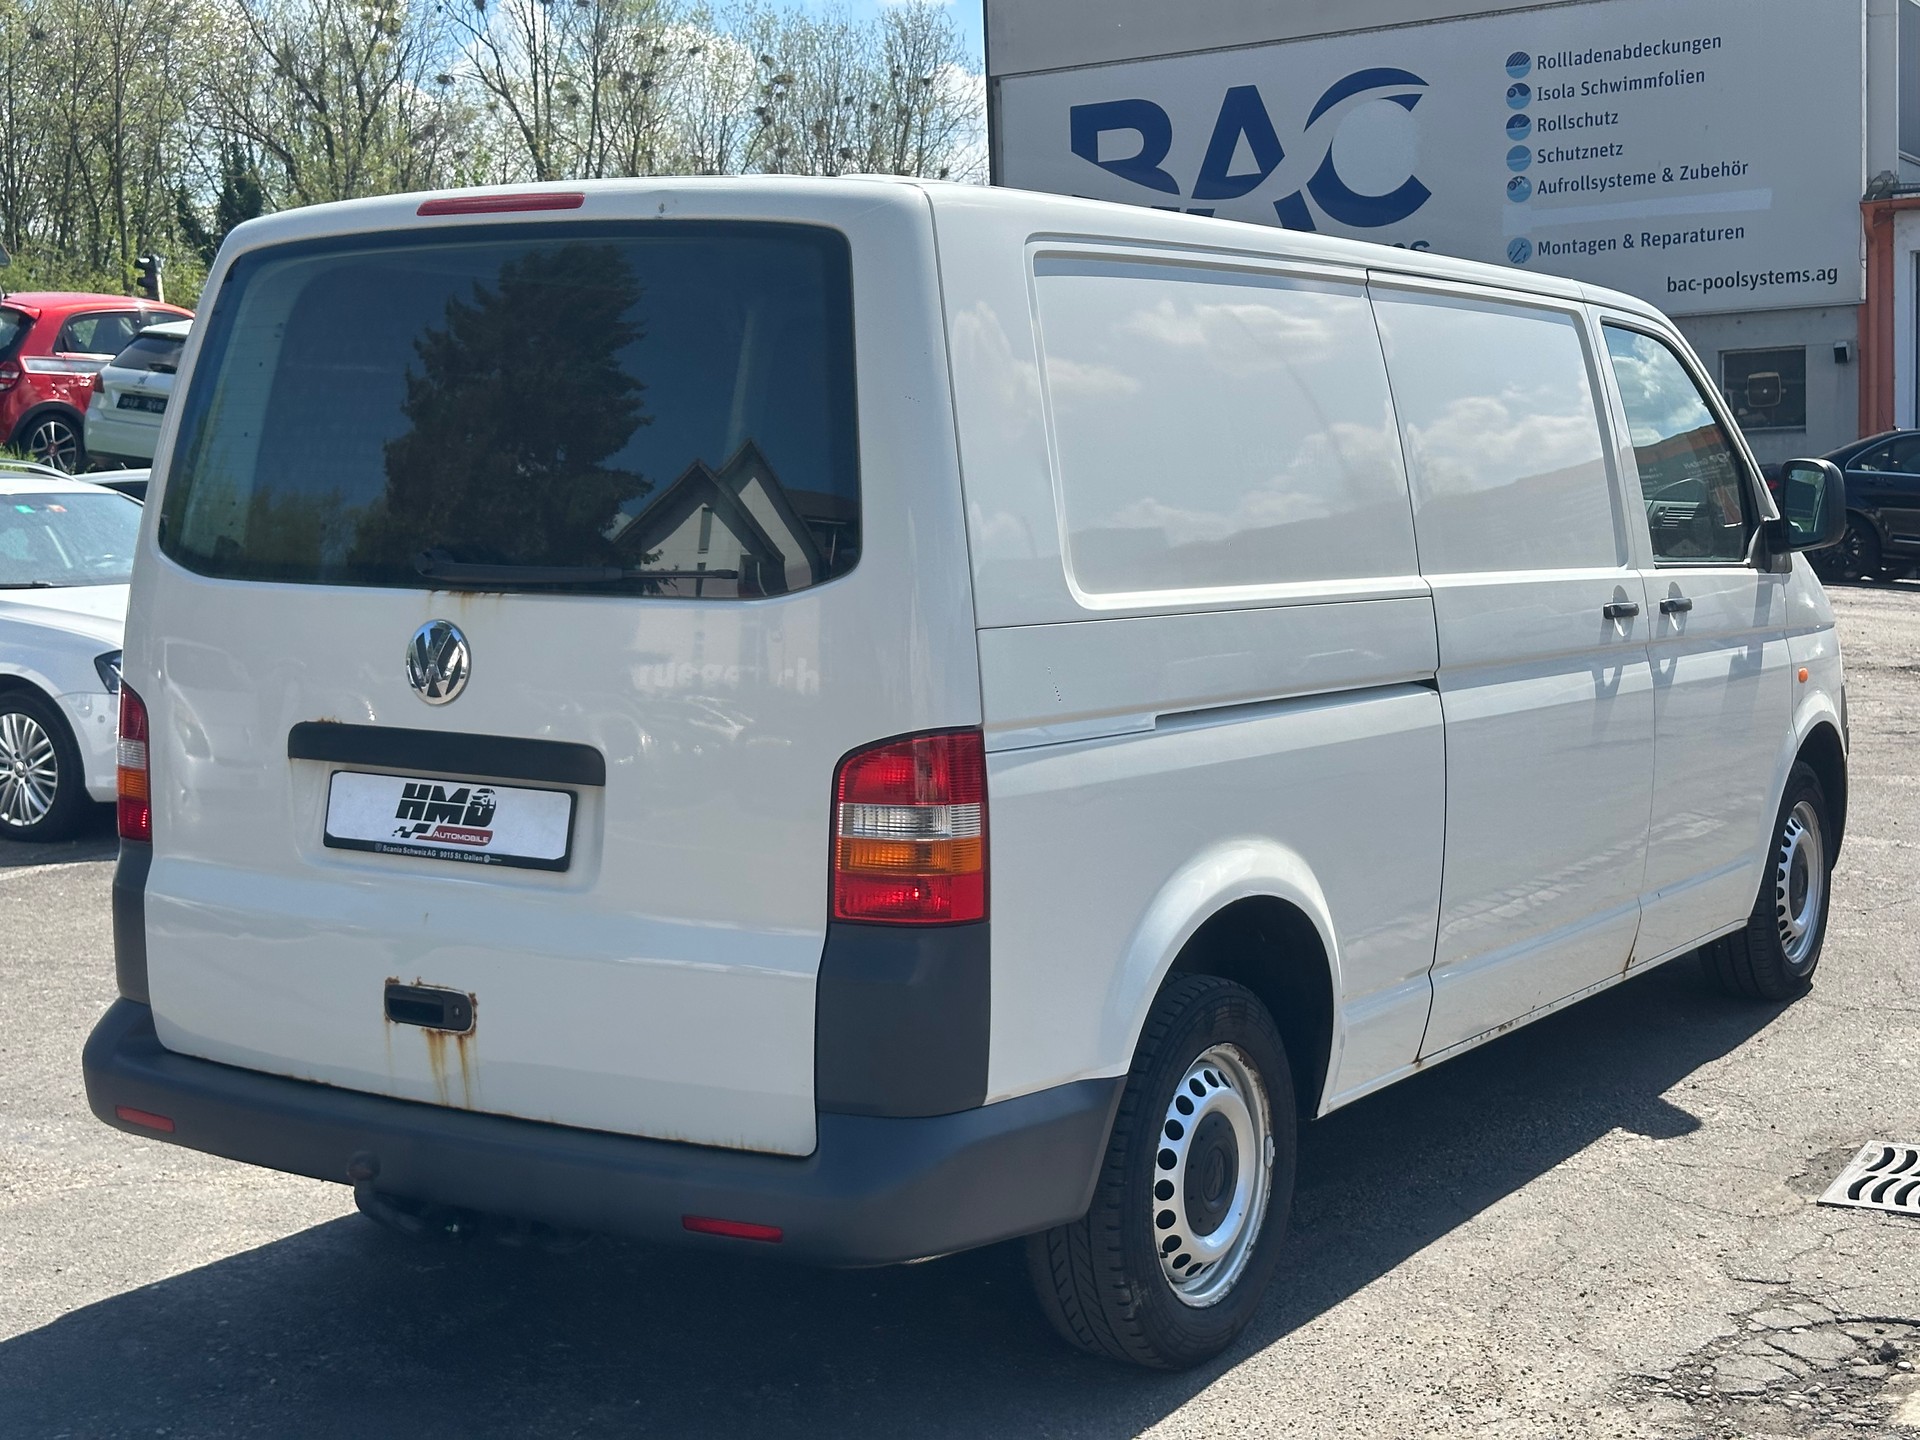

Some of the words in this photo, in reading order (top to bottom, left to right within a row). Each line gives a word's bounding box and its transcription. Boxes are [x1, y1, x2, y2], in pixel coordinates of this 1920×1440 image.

[1537, 35, 1722, 70] Rollladenabdeckungen
[1537, 82, 1575, 101] Isola
[1581, 69, 1705, 96] Schwimmfolien
[1537, 111, 1619, 132] Rollschutz
[1537, 143, 1623, 164] Schutznetz
[1537, 171, 1656, 195] Aufrollsysteme
[1662, 167, 1674, 182] &
[1680, 160, 1749, 181] Zubehör
[1538, 236, 1616, 257] Montagen
[1623, 234, 1635, 249] &
[1641, 226, 1745, 250] Reparaturen
[1667, 267, 1838, 294] bac-poolsystems.ag
[433, 831, 490, 843] AUTOMOBILE
[383, 844, 403, 854] Scania
[403, 847, 427, 857] Schweiz
[427, 849, 437, 857] AG
[440, 851, 454, 859] 9015
[464, 853, 483, 862] Gallen
